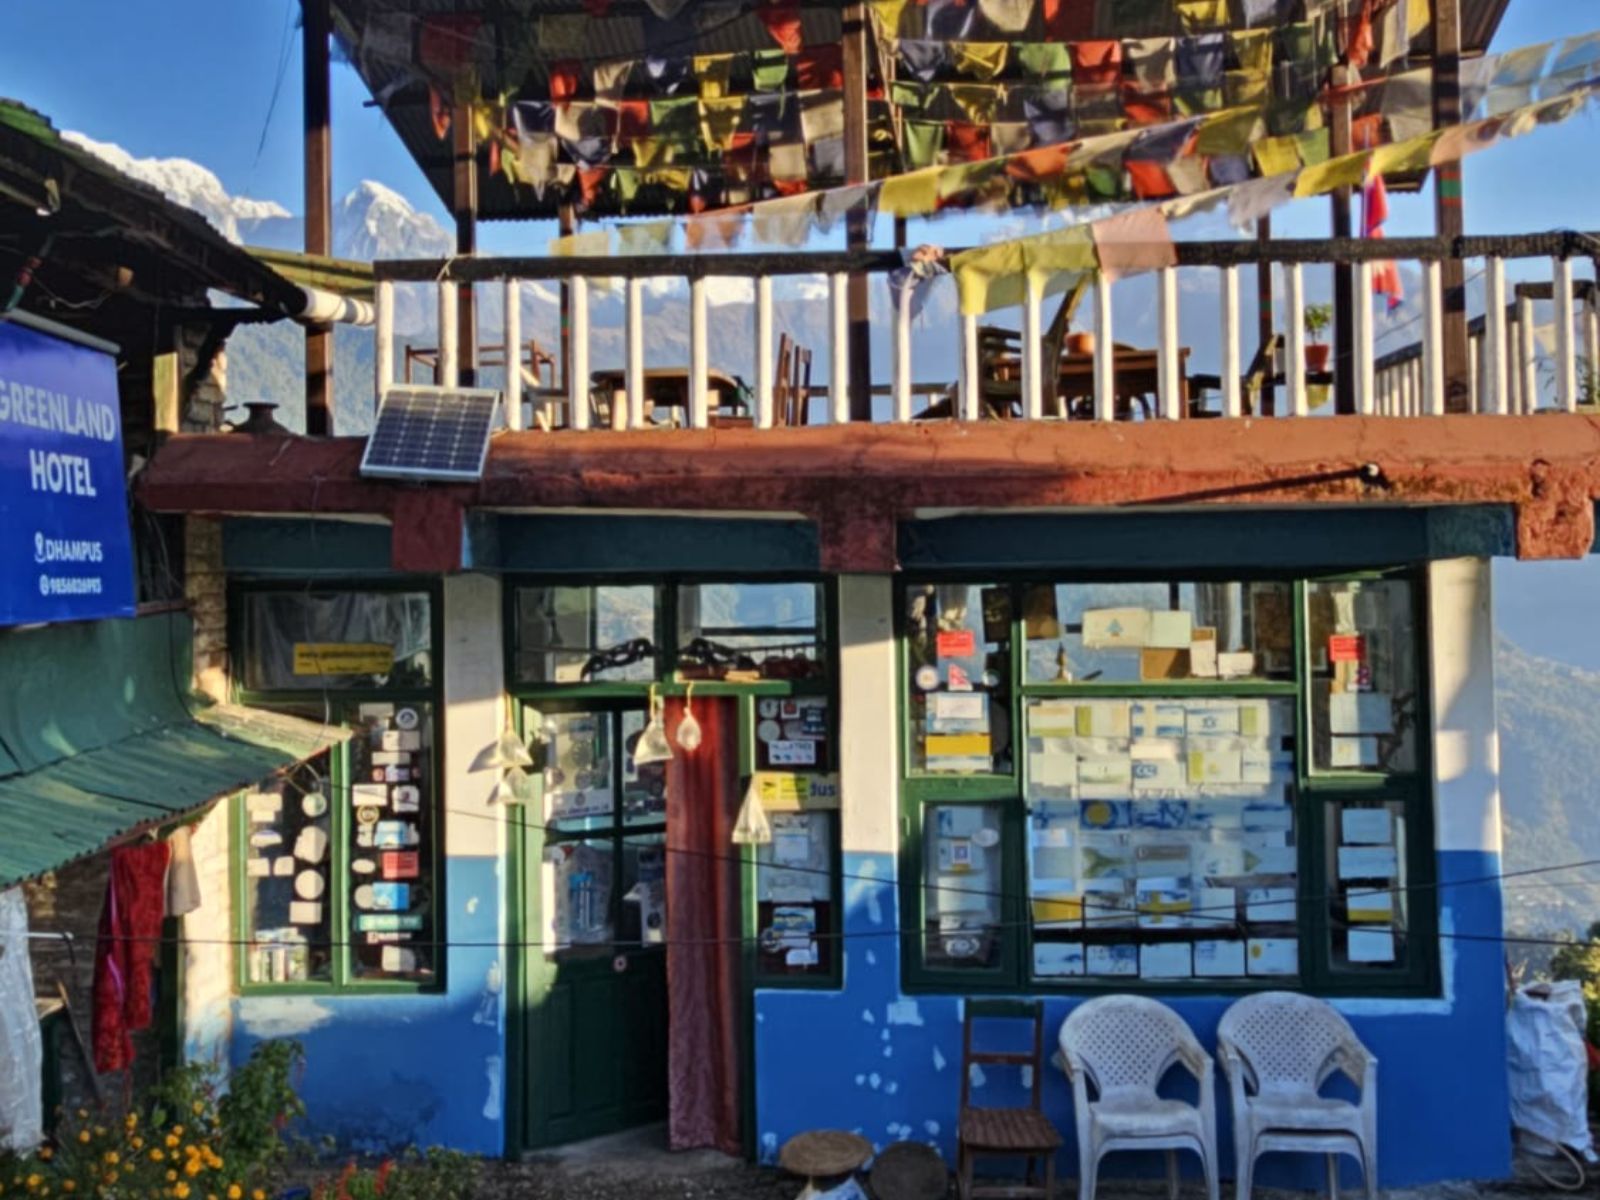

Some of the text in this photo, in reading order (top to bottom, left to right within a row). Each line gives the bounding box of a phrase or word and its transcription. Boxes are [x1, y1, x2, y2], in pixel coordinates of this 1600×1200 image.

[0, 379, 116, 442] GREENLAND
[29, 448, 97, 497] HOTEL
[45, 538, 103, 562] DHAMPUS
